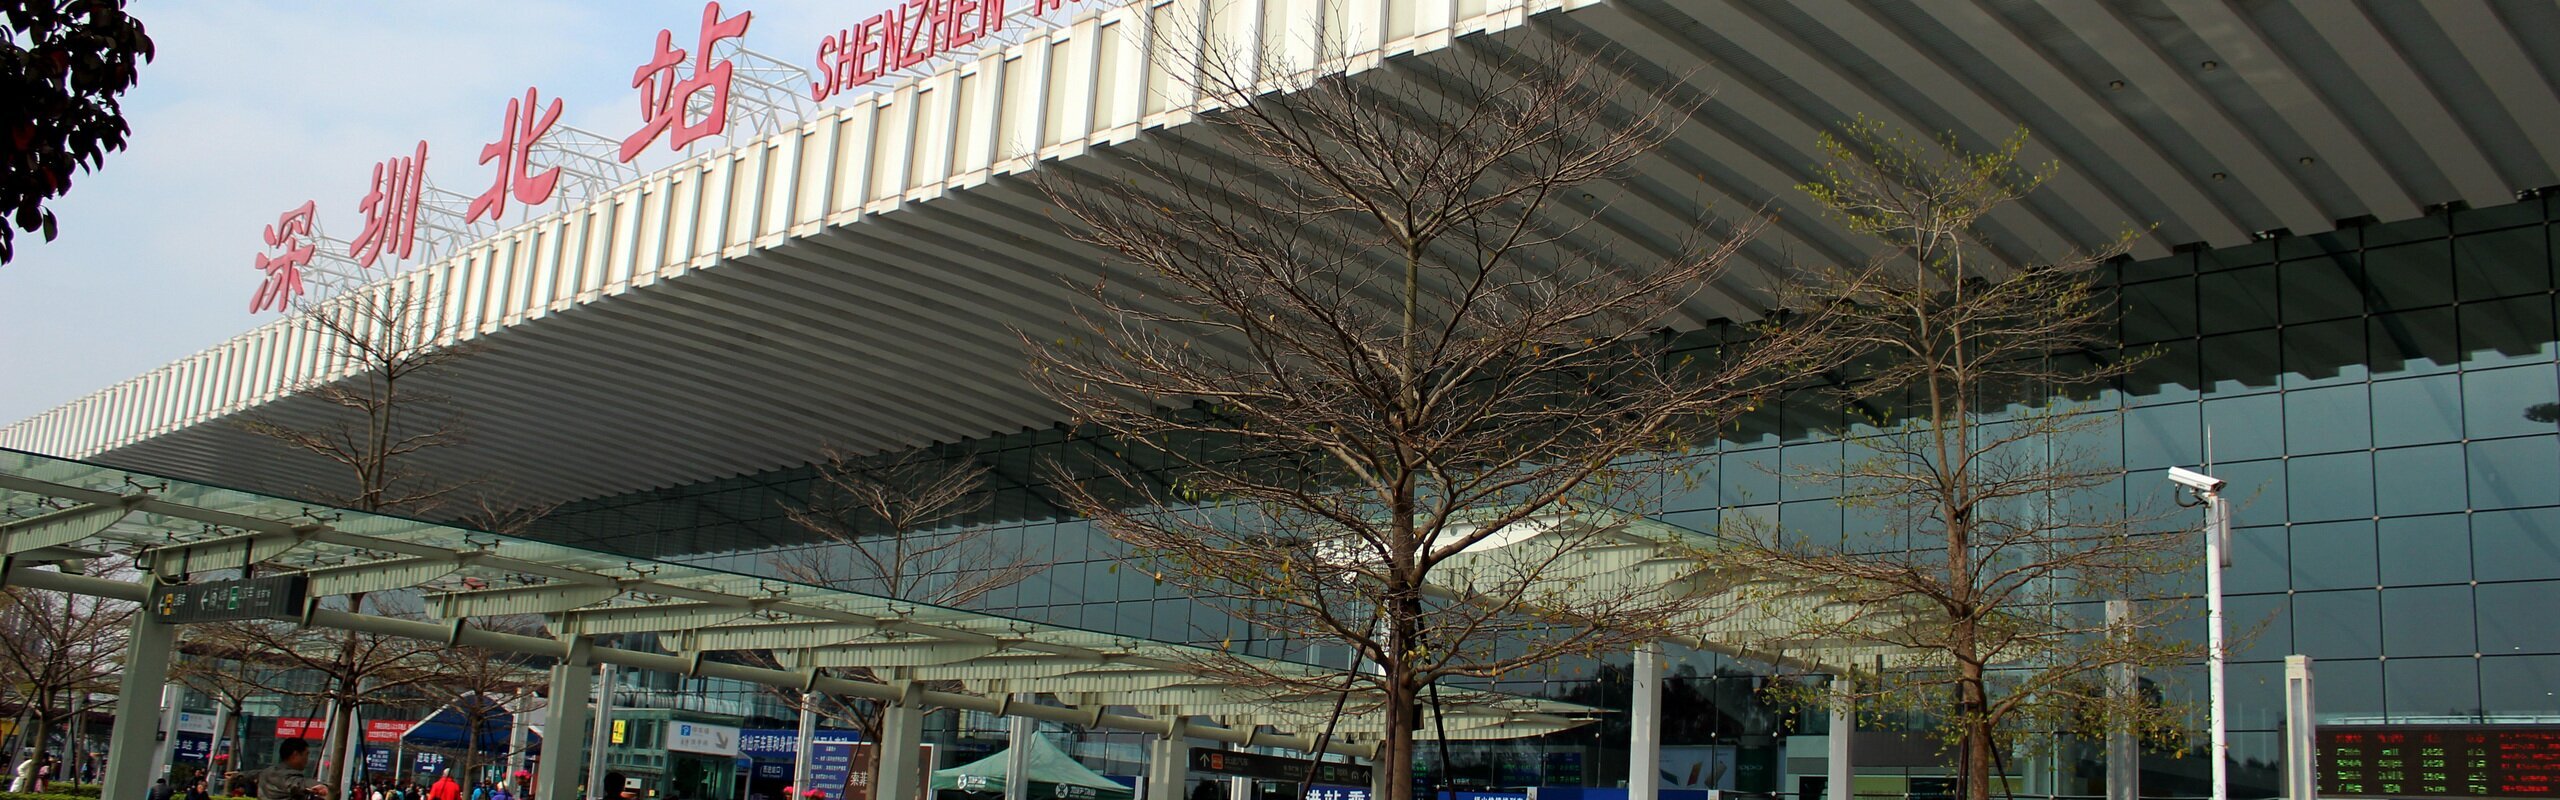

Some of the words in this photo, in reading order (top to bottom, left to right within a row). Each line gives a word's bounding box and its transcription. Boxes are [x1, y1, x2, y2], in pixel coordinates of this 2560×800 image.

[811, 0, 1004, 102] SHENZHEN
[250, 1, 752, 314] 深圳北站
[738, 735, 799, 752] 动出示车票和身份证
